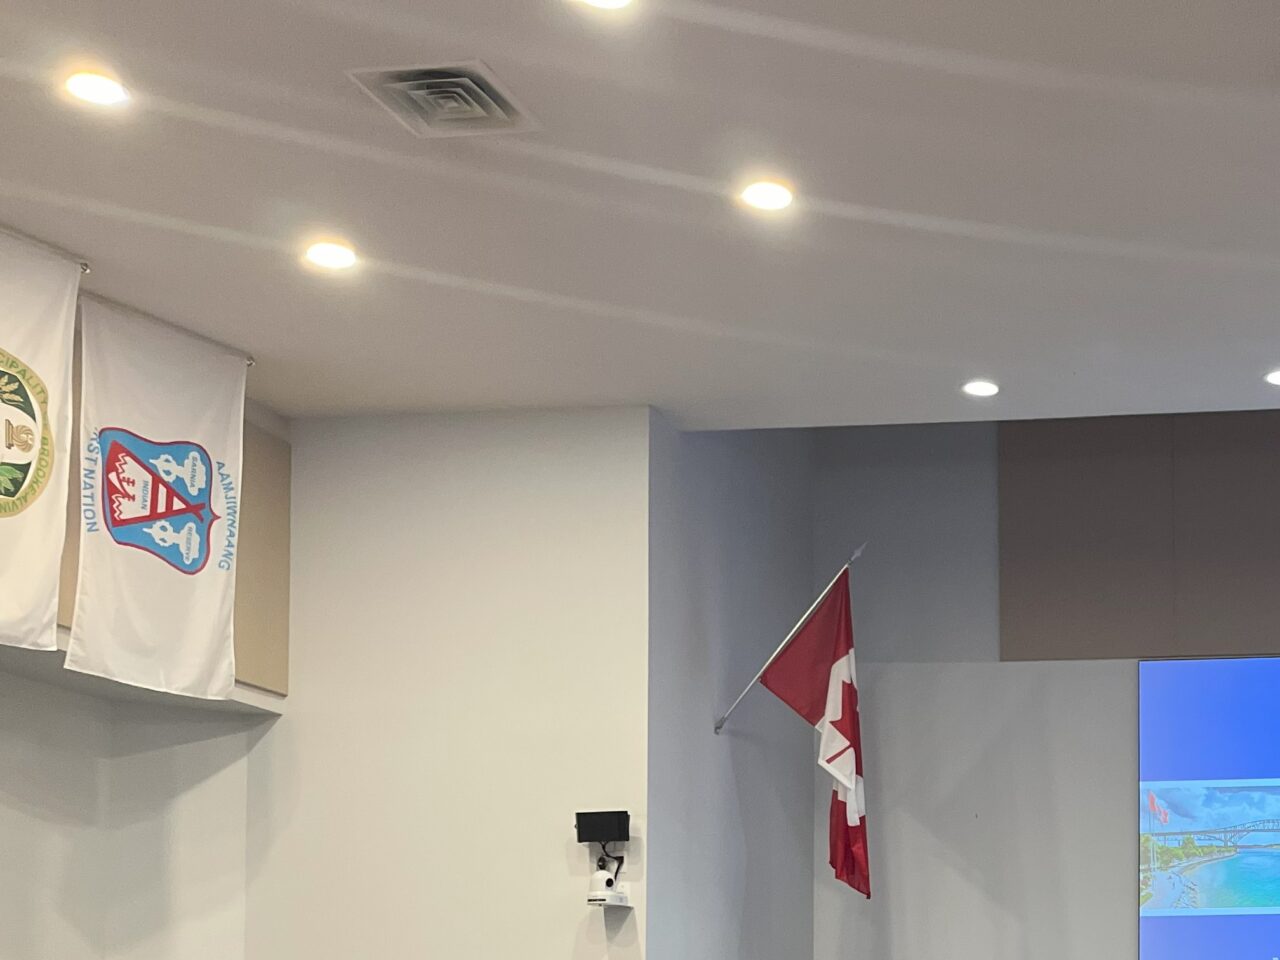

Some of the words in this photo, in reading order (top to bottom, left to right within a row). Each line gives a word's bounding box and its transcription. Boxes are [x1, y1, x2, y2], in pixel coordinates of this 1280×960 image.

[141, 480, 149, 511] INDIAN
[189, 456, 198, 488] SARNIA
[83, 467, 99, 533] NATION
[216, 461, 237, 571] AAMJIWNAANG
